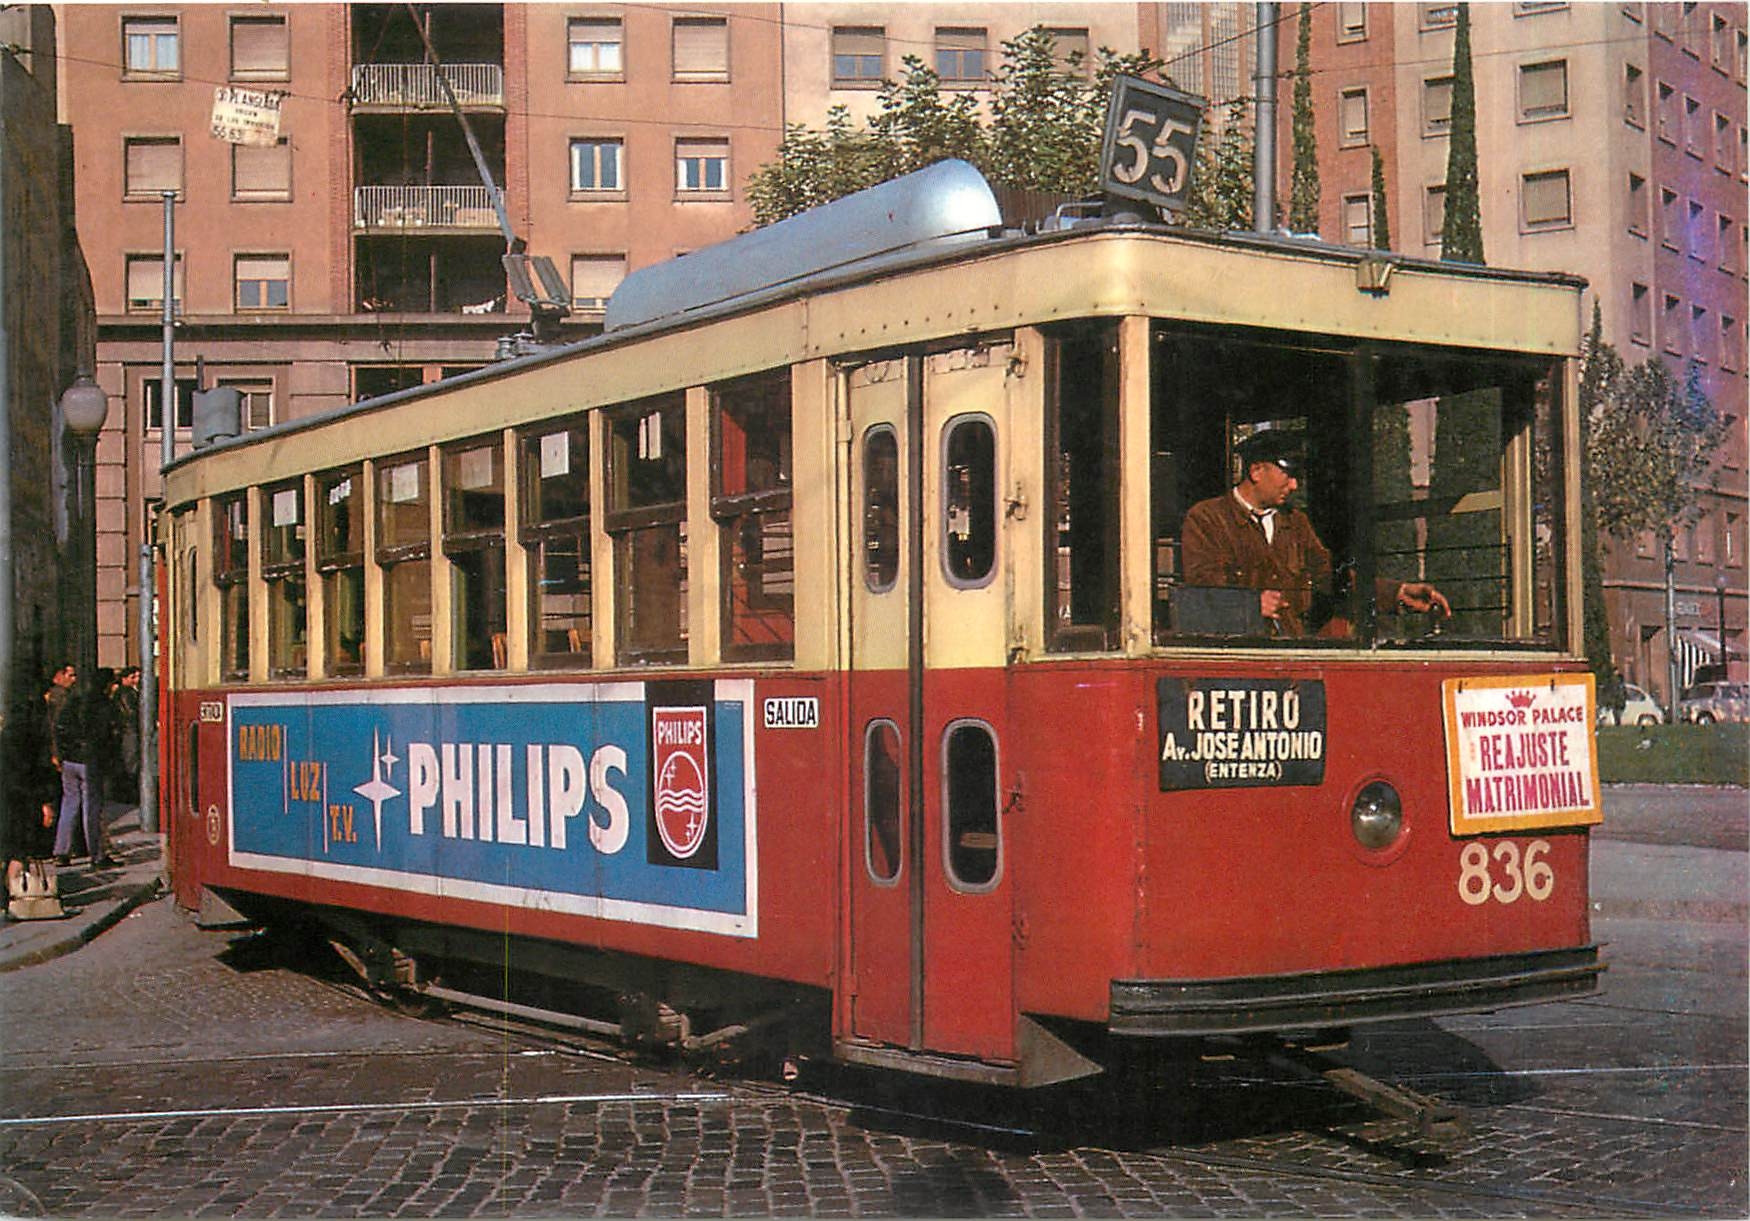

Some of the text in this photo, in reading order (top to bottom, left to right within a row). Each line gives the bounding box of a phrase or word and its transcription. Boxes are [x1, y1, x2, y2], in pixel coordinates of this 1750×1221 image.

[1113, 109, 1193, 193] 55
[766, 701, 816, 725] SALIDA
[1188, 689, 1299, 730] RETIRO
[1461, 706, 1584, 728] WINDSOR PALACE
[239, 724, 281, 761] RADIO
[657, 720, 702, 745] PHILIPS
[1190, 732, 1239, 760] JOSE
[1240, 731, 1323, 760] ANTONIO
[1479, 731, 1570, 771] REAJUSTE
[290, 760, 320, 801] LUZ
[408, 743, 630, 854] PHILIPS
[1465, 771, 1590, 814] MATRIMONIAL
[329, 804, 357, 842] T.V.
[1459, 840, 1554, 905] 836
